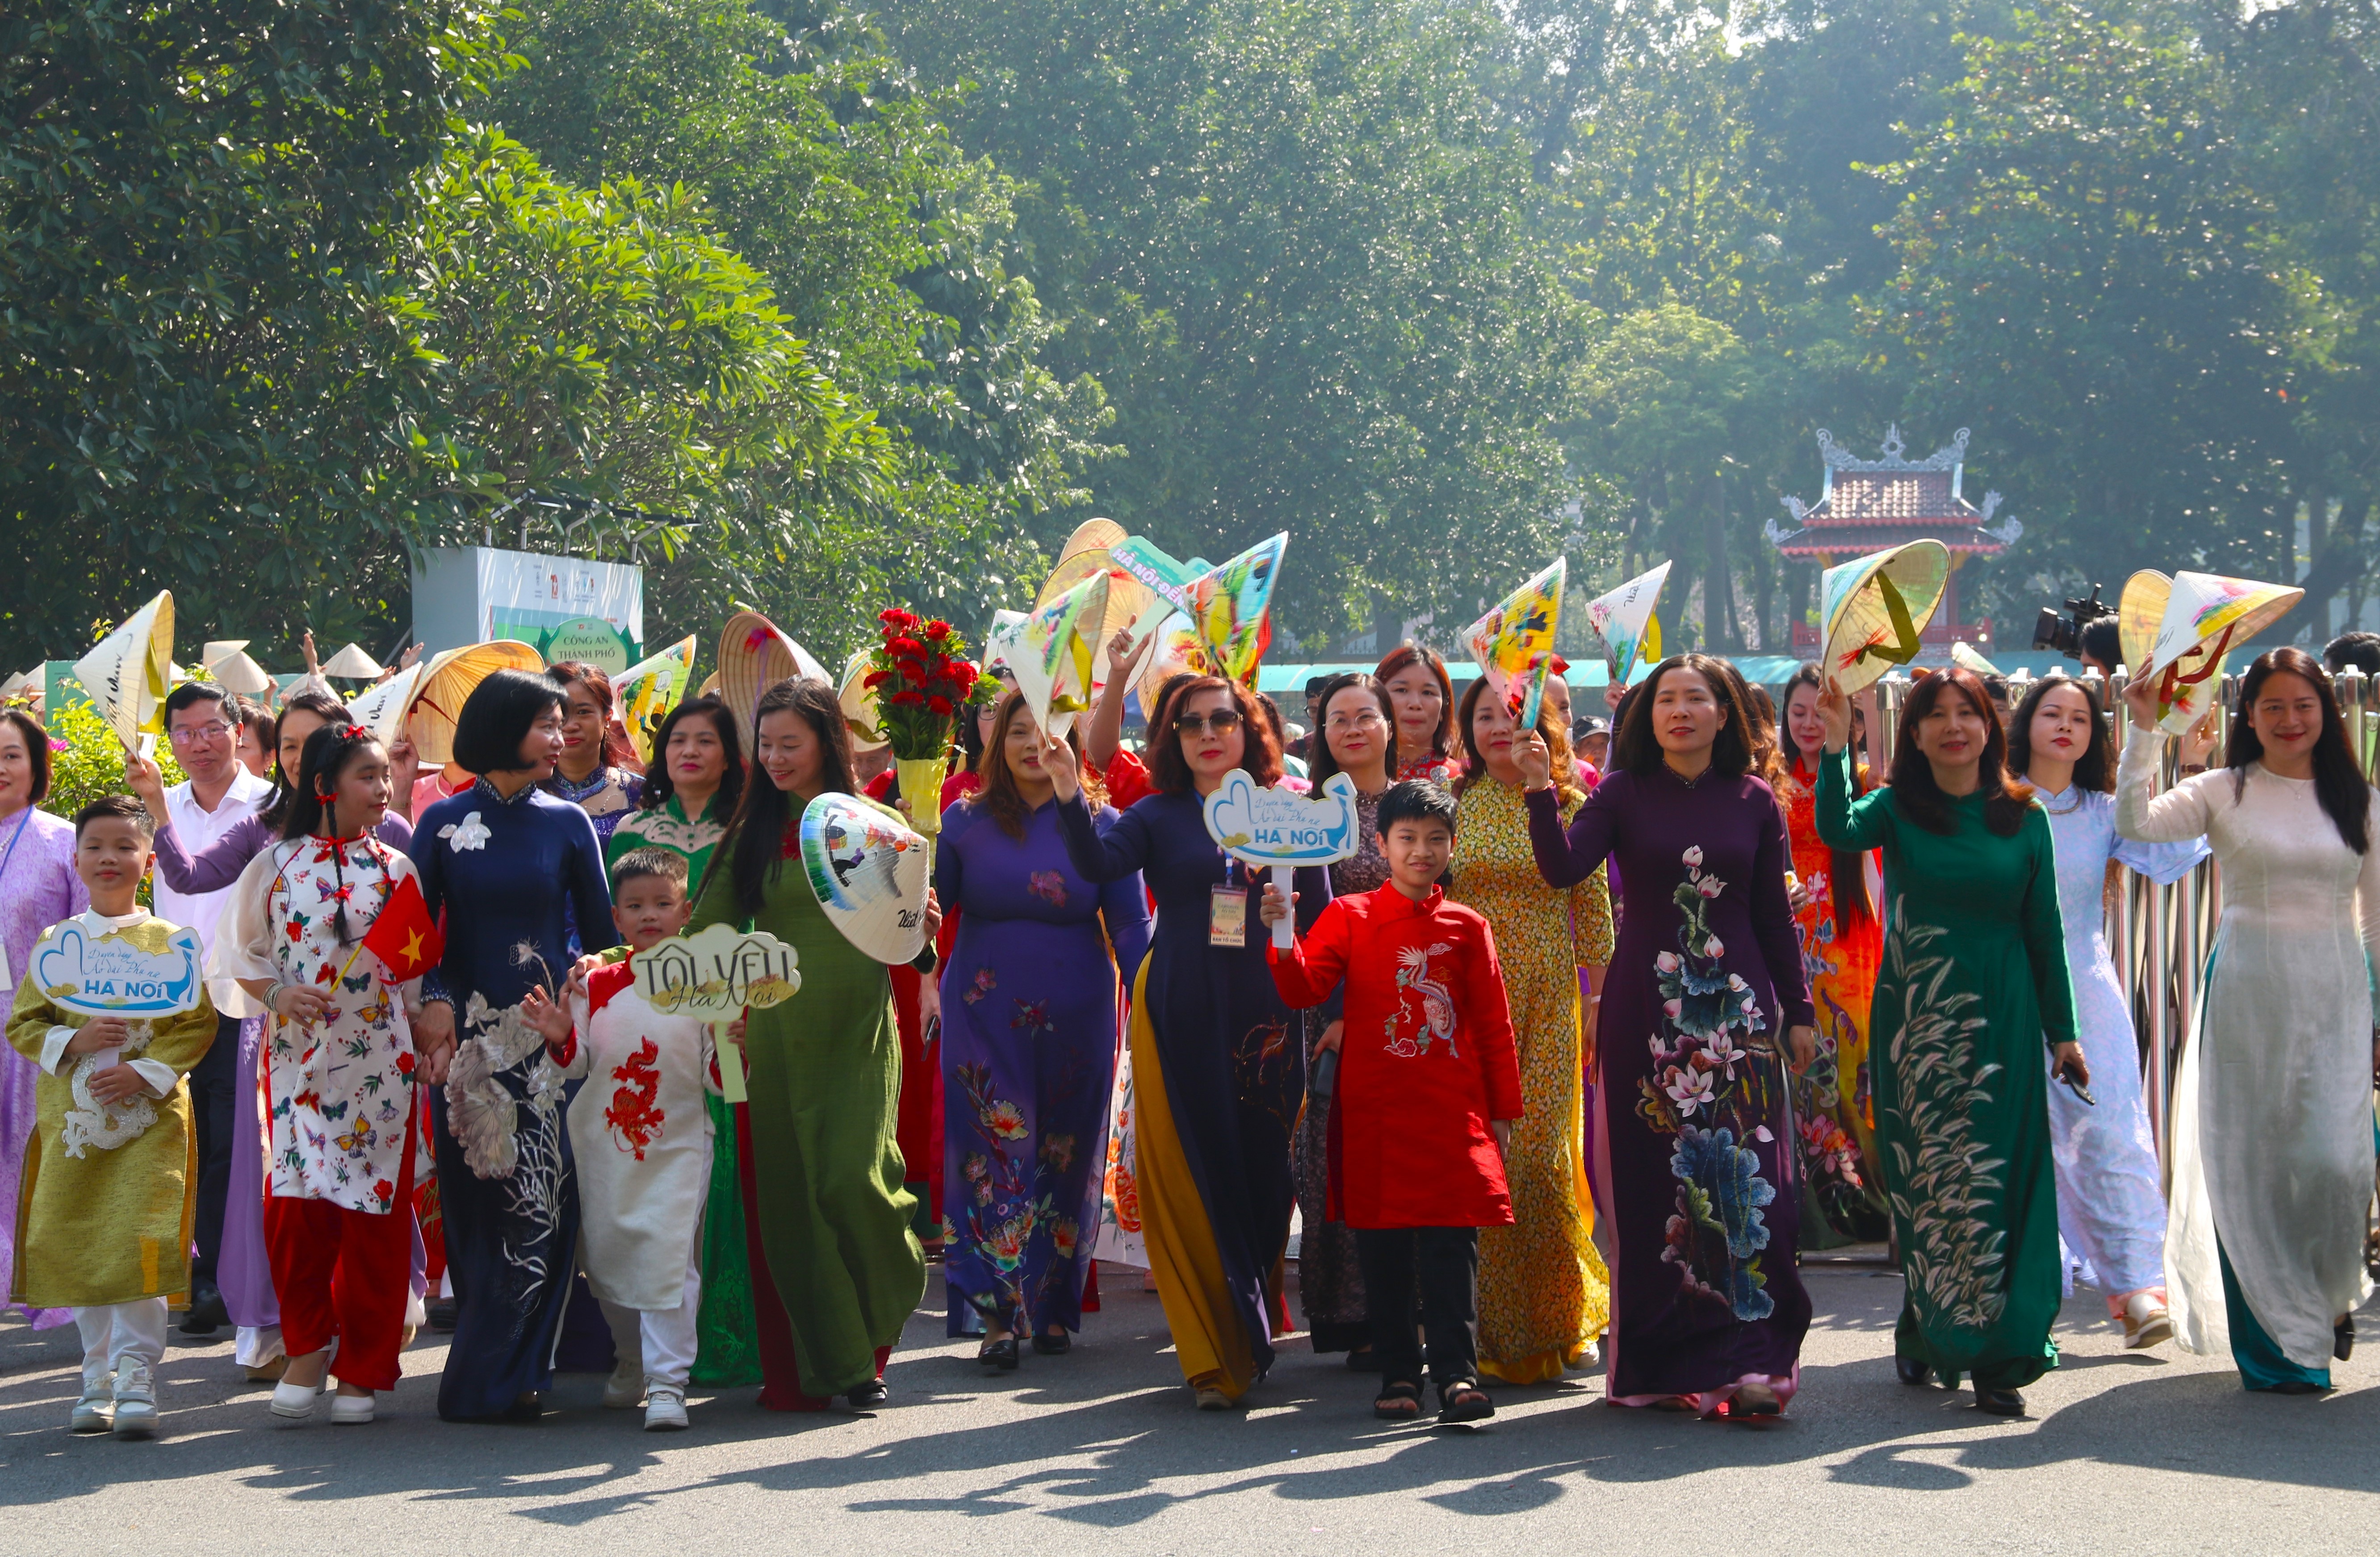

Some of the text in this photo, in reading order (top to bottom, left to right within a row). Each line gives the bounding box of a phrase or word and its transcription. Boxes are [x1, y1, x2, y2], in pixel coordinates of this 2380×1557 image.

[1111, 547, 1136, 568] HÀ
[1131, 562, 1161, 587] NỘI
[558, 646, 616, 659] THÀNH PHỐ
[563, 635, 608, 645] CÔNG AN
[637, 939, 789, 995] TÔI YÊU
